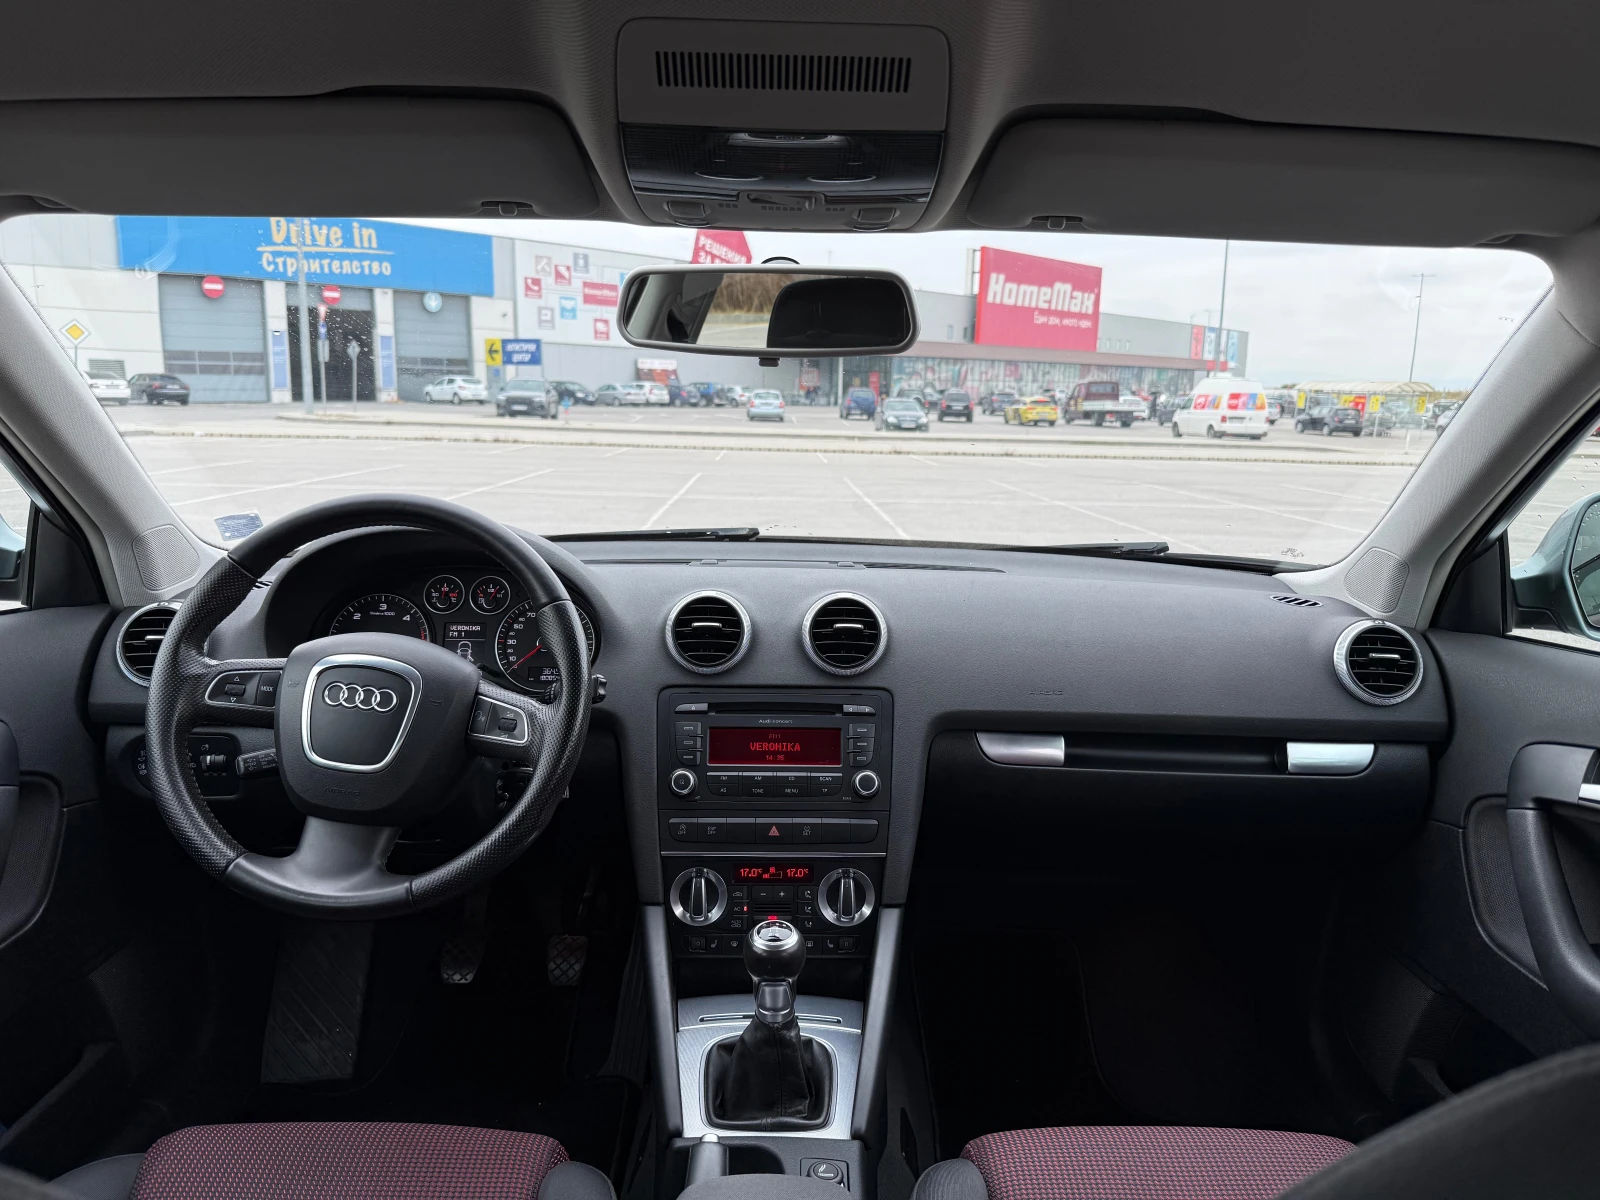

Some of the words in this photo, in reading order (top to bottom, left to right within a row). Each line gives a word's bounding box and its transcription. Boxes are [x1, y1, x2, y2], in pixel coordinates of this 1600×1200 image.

[269, 217, 343, 246] Drive
[352, 221, 378, 248] in
[262, 252, 392, 276] Строителство
[986, 272, 1095, 315] HomeMax
[749, 742, 801, 751] VERONIKA
